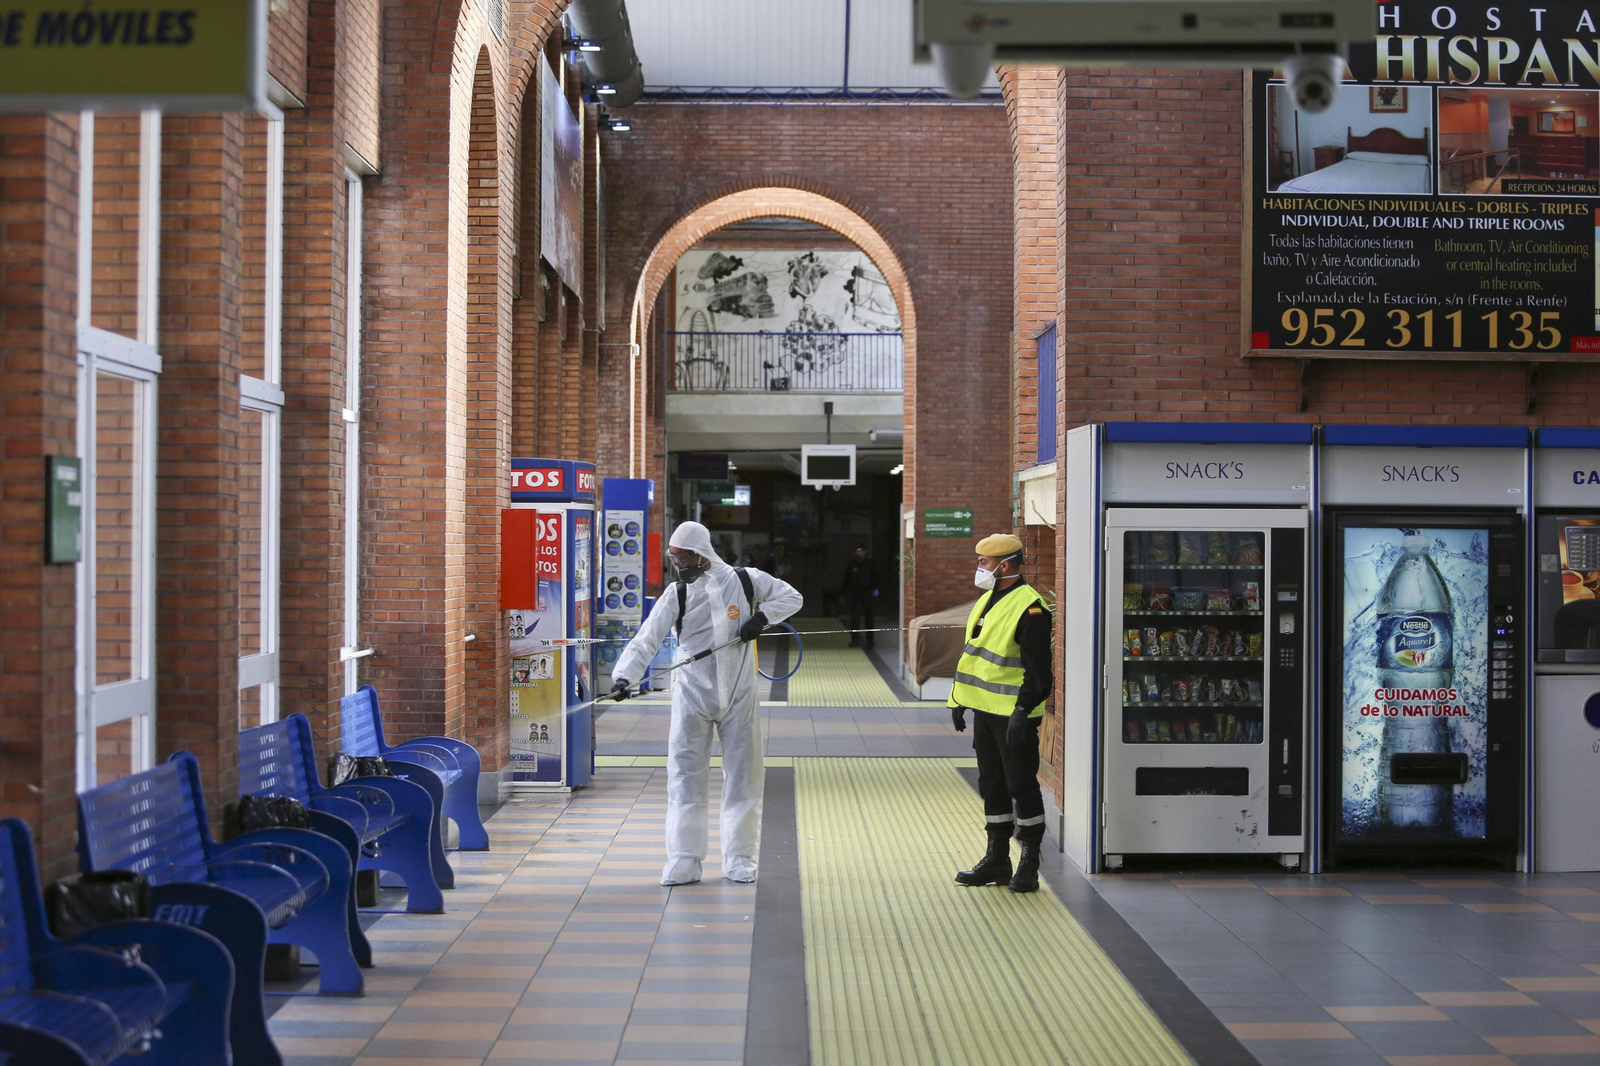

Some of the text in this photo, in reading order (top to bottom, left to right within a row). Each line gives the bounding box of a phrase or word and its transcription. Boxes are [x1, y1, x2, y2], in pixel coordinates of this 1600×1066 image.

[34, 1, 197, 46] MÓVILES
[1508, 182, 1597, 194] RECEPCIÓN 24 HORAS
[1262, 197, 1365, 212] HABITACIONES
[1368, 199, 1466, 214] INDIVIDUALES
[1477, 201, 1529, 214] DOBLES
[1540, 202, 1589, 216] TRIPLES
[1281, 214, 1566, 231] INDIVIDUAL, DOUBLE AND TRIPLE ROOMS
[1269, 234, 1414, 249] Todas las habitaciones tienen
[1434, 239, 1589, 258] Bathroom, TV, Air Conditioning
[1263, 252, 1421, 270] baño, TV y Aire Acondicionado
[1446, 257, 1577, 276] or central heating included
[1305, 271, 1377, 286] o Calefacción.
[1480, 277, 1544, 291] in the rooms.
[1277, 291, 1568, 308] Explanada de la Estación, s/n (Frente a Renfe)
[1281, 307, 1562, 350] 952 311 135
[1165, 460, 1244, 480] SNACK'S
[1381, 463, 1460, 483] SNACK'S
[1398, 636, 1433, 649] Aquarel
[1374, 688, 1458, 701] CUIDAMOS
[1360, 703, 1471, 717] de lo NATURAL
